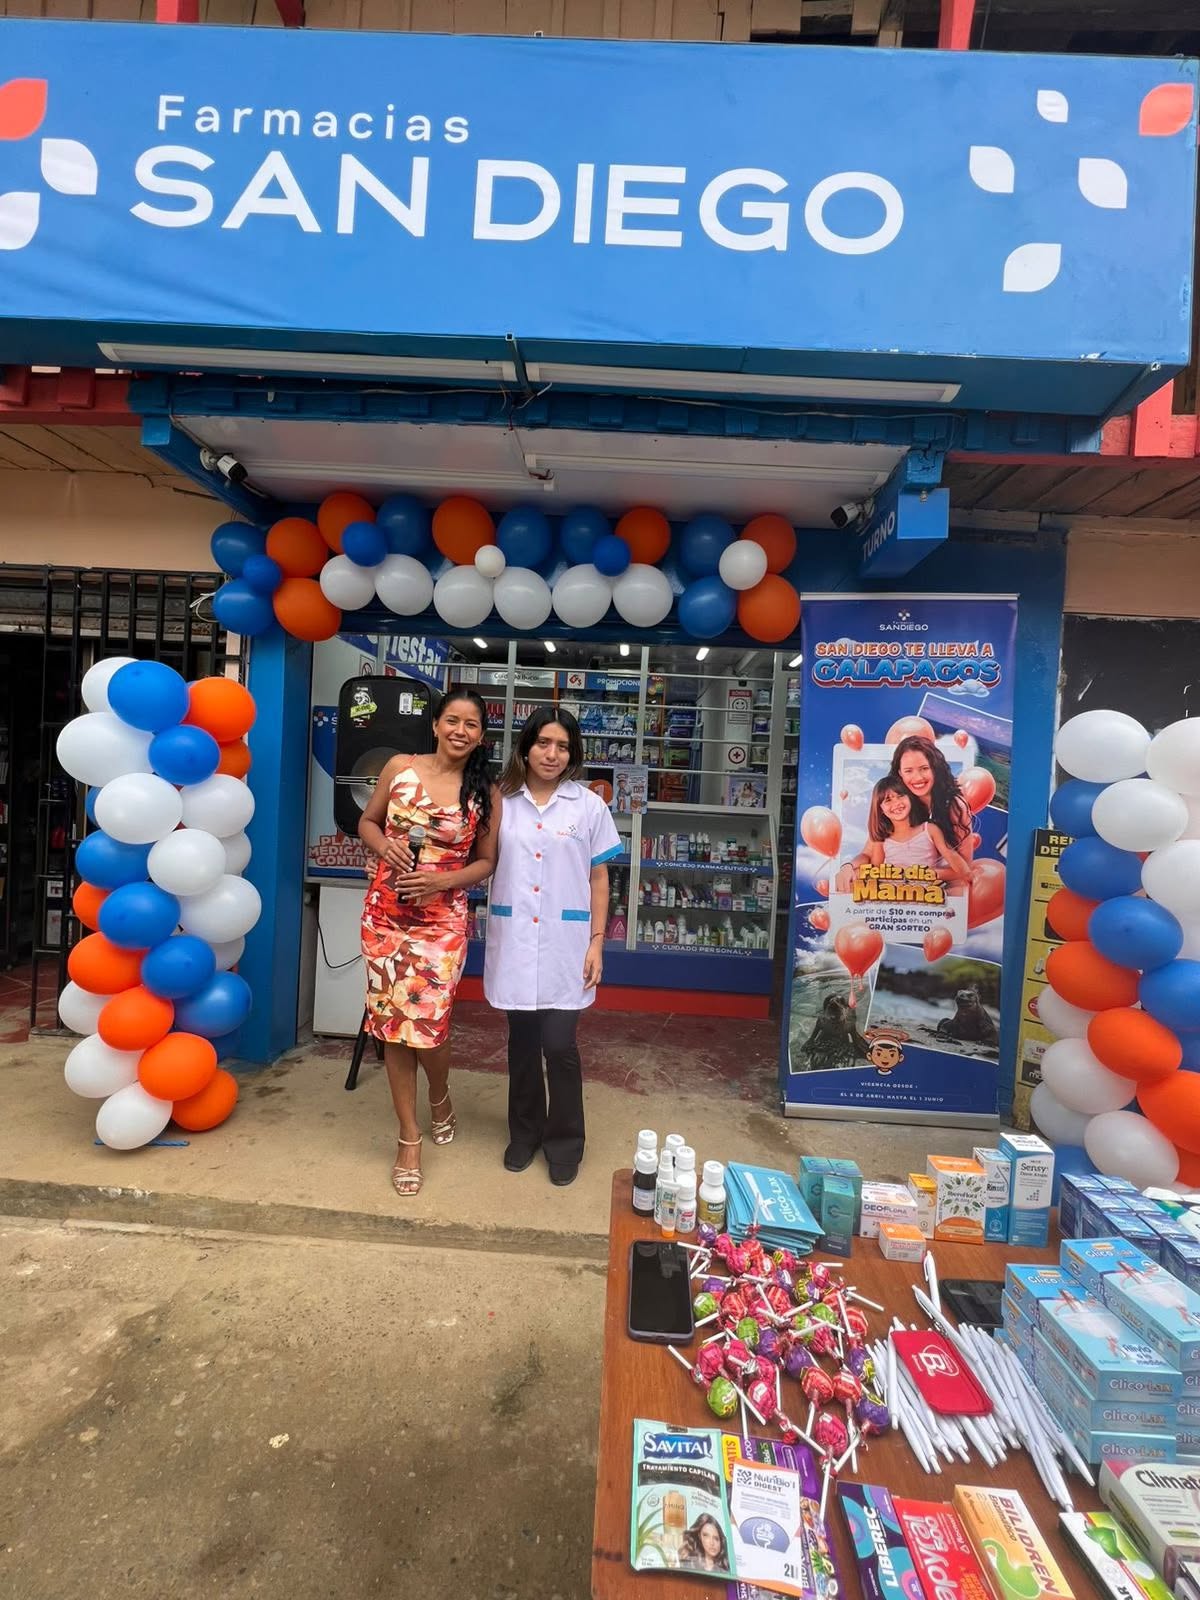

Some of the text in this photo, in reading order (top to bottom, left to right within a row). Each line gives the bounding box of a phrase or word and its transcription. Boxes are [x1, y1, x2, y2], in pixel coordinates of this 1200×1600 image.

[157, 94, 471, 144] Farmacias
[129, 145, 905, 256] SAN DIEGO
[864, 511, 895, 562] TURNO
[815, 641, 995, 659] SAN DIEGO TE LLEVA A
[812, 658, 1001, 688] GALAPAGOS
[597, 678, 641, 688] PROMOCIONE
[320, 836, 363, 846] PLAN
[1041, 845, 1065, 856] DE
[697, 864, 749, 872] FARMACEUTICO
[859, 863, 938, 882] Feliz día
[853, 879, 946, 905] Mamá
[853, 907, 875, 915] partir
[889, 908, 904, 916] $10
[919, 910, 956, 919] compras
[865, 916, 907, 924] participas
[895, 924, 931, 932] SORTEO
[662, 944, 744, 955] CUIDADO PERSONAL
[768, 1176, 796, 1222] Glico Lax
[1109, 1378, 1144, 1391] Glico
[1103, 1409, 1137, 1422] Glico
[644, 1431, 714, 1459] SAVITAL
[1101, 1443, 1136, 1456] Glico
[642, 1463, 716, 1481] TRATAMIENTO CAPILAR
[1135, 1469, 1200, 1490] Climat
[754, 1481, 782, 1492] DIGEST
[924, 1515, 949, 1552] 500
[863, 1504, 899, 1588] LIBEREC
[1000, 1495, 1059, 1595] BILIDREN
